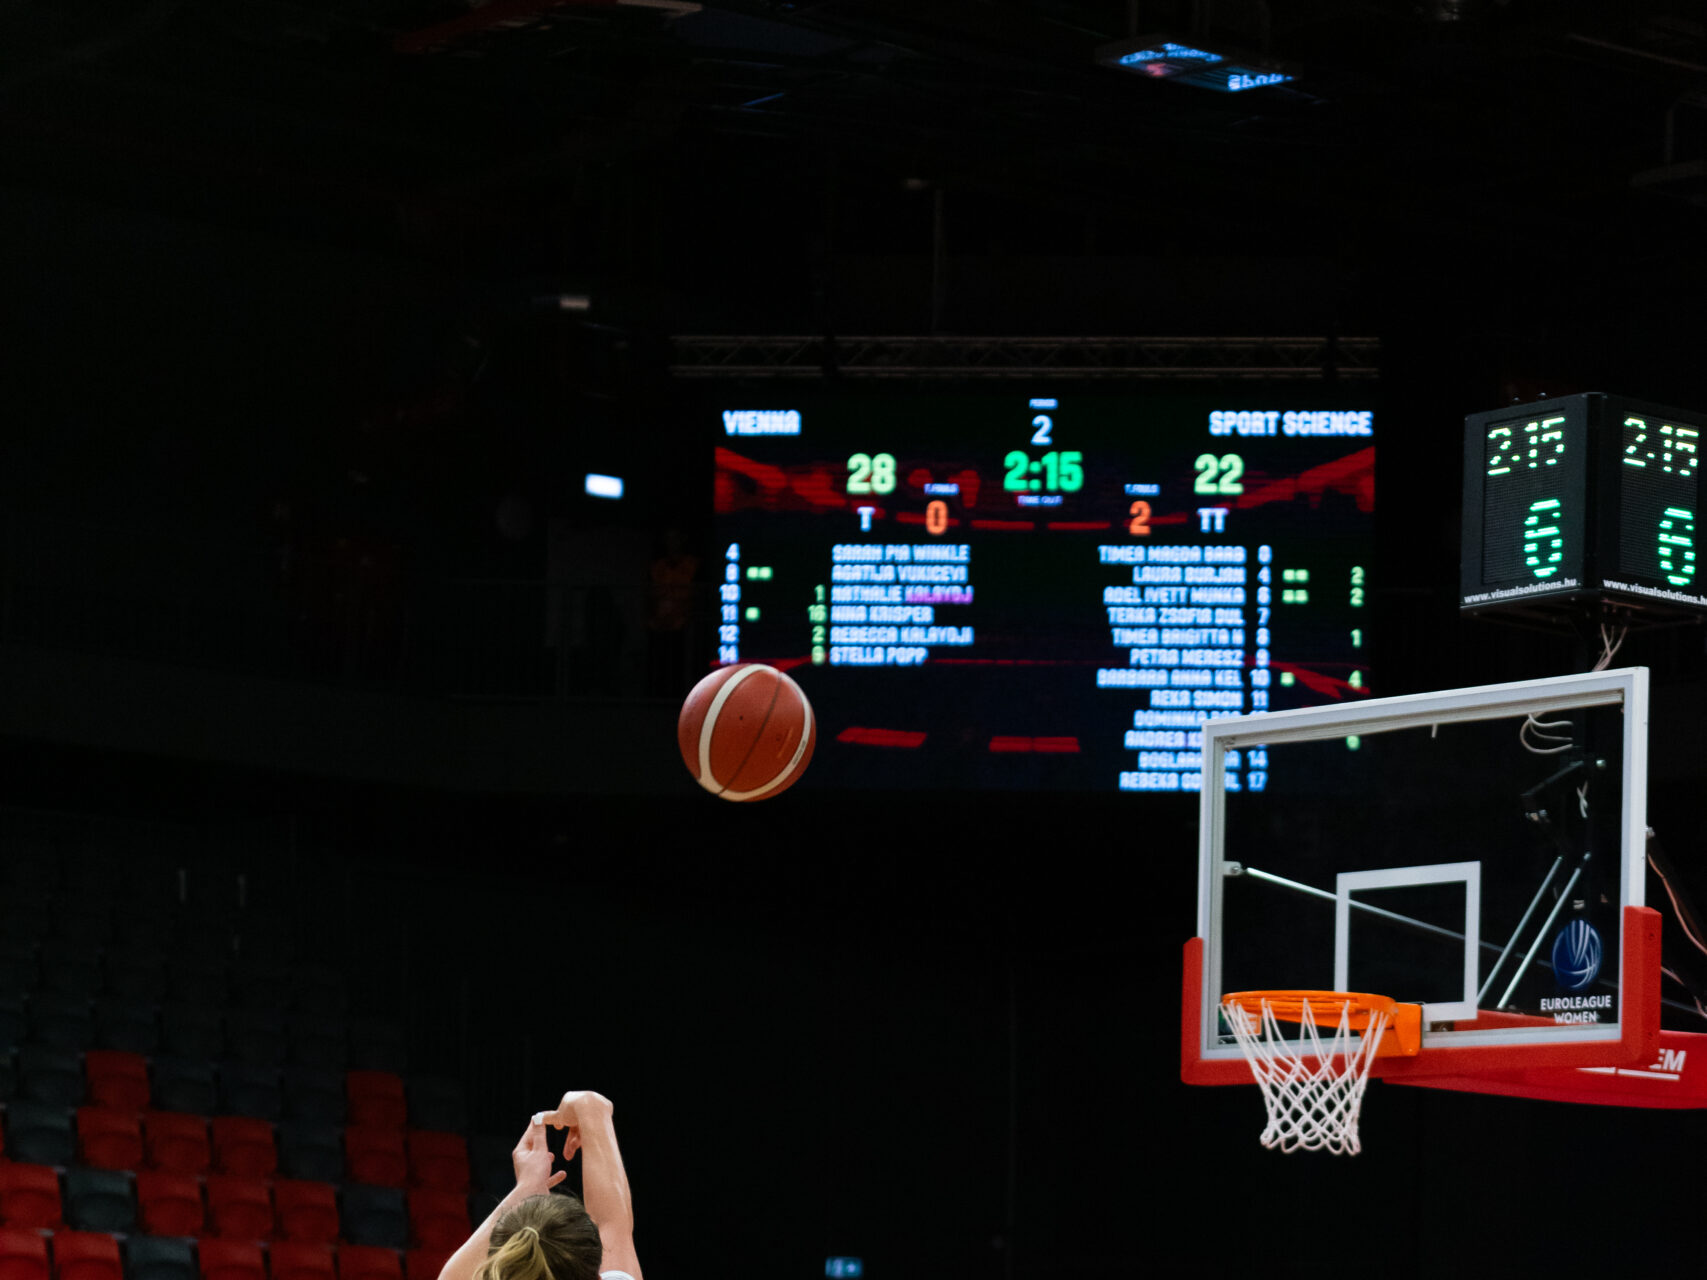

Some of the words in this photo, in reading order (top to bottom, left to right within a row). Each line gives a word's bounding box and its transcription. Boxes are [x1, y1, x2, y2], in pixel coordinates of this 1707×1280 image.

[722, 410, 801, 436] VIENNA
[1031, 415, 1052, 446] 2
[1209, 411, 1280, 436] SPORT
[1282, 411, 1374, 436] SCIENCE
[846, 453, 897, 495] 28
[1003, 450, 1083, 493] 2:15
[1193, 453, 1244, 495] 22
[857, 506, 876, 532] T
[925, 500, 948, 535] 0
[1128, 500, 1151, 536] 2
[1197, 507, 1229, 533] TT
[1524, 498, 1563, 578] 6
[1658, 507, 1697, 586] 6
[726, 544, 739, 562] 4
[1257, 566, 1271, 585] 4
[1351, 566, 1364, 586] 2
[815, 585, 825, 602] 1
[1350, 588, 1364, 606] 2
[1464, 577, 1577, 604] www.visualsolutions.hu
[1257, 607, 1270, 626] 7
[718, 625, 740, 645] 12
[812, 625, 825, 644] 2
[1350, 629, 1361, 647] 1
[718, 645, 739, 664] 14
[829, 646, 885, 665] STELLA
[886, 646, 929, 665] POPP
[1130, 648, 1181, 668] PETRA
[1348, 670, 1361, 690] 4
[1251, 690, 1269, 710] 11
[1248, 751, 1269, 769] 14
[1248, 771, 1268, 791] 17
[1540, 995, 1612, 1010] EUROLEAGUE
[1553, 1011, 1597, 1024] WOMEN
